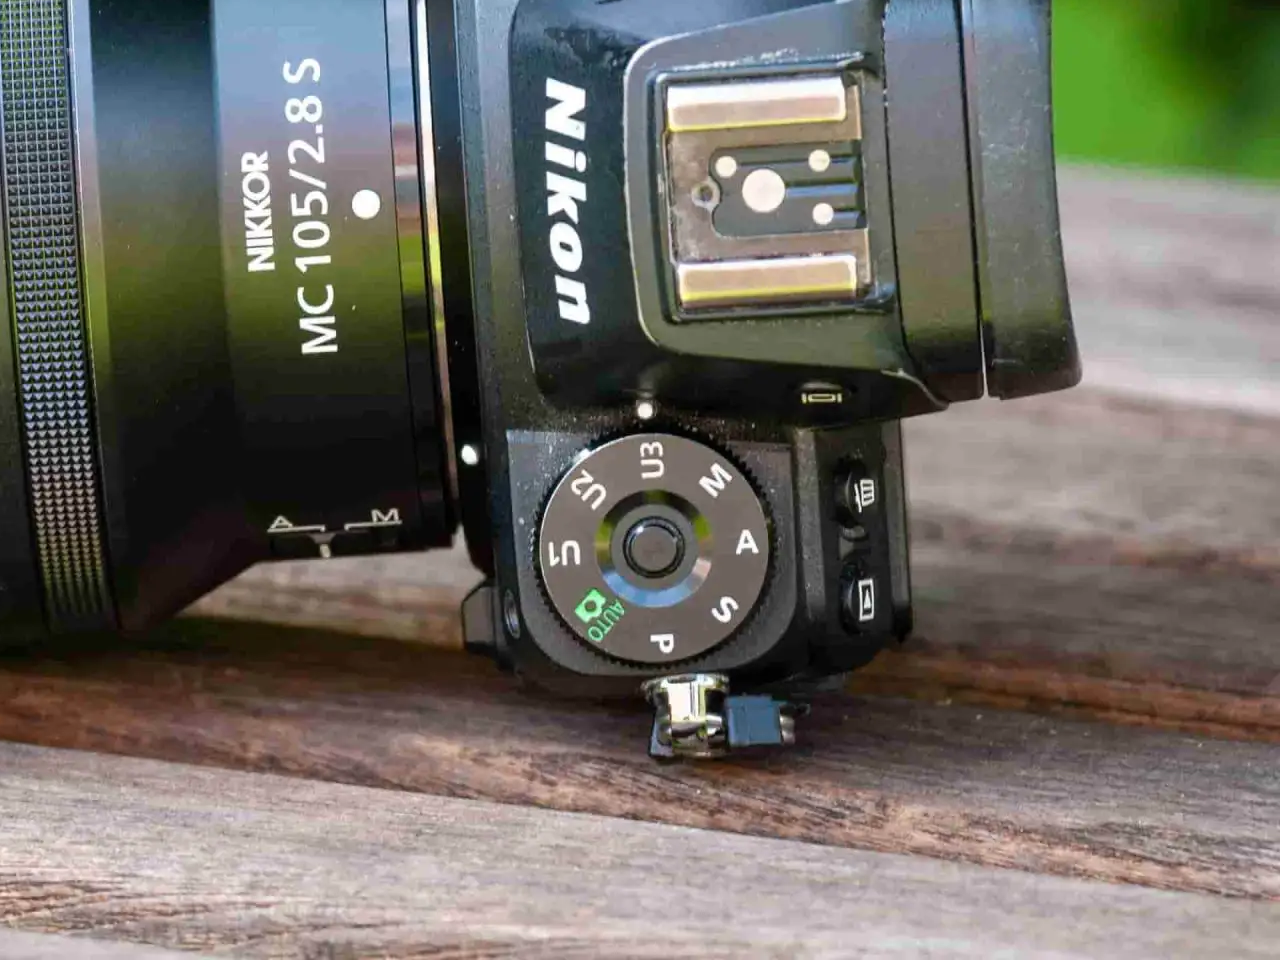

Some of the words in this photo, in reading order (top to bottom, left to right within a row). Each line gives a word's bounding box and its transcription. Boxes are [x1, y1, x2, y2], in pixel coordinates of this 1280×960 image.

[282, 56, 322, 83] S
[285, 96, 333, 274] 105/2.8
[544, 76, 591, 326] Nikon
[240, 150, 276, 272] NIKKOR
[296, 284, 339, 355] MC
[640, 441, 665, 480] U3
[570, 469, 608, 511] U2
[698, 463, 733, 498] M
[370, 507, 401, 523] M
[548, 539, 582, 567] U1
[735, 529, 760, 556] A
[587, 596, 626, 643] AUTO
[711, 595, 740, 623] S
[649, 632, 675, 654] P
